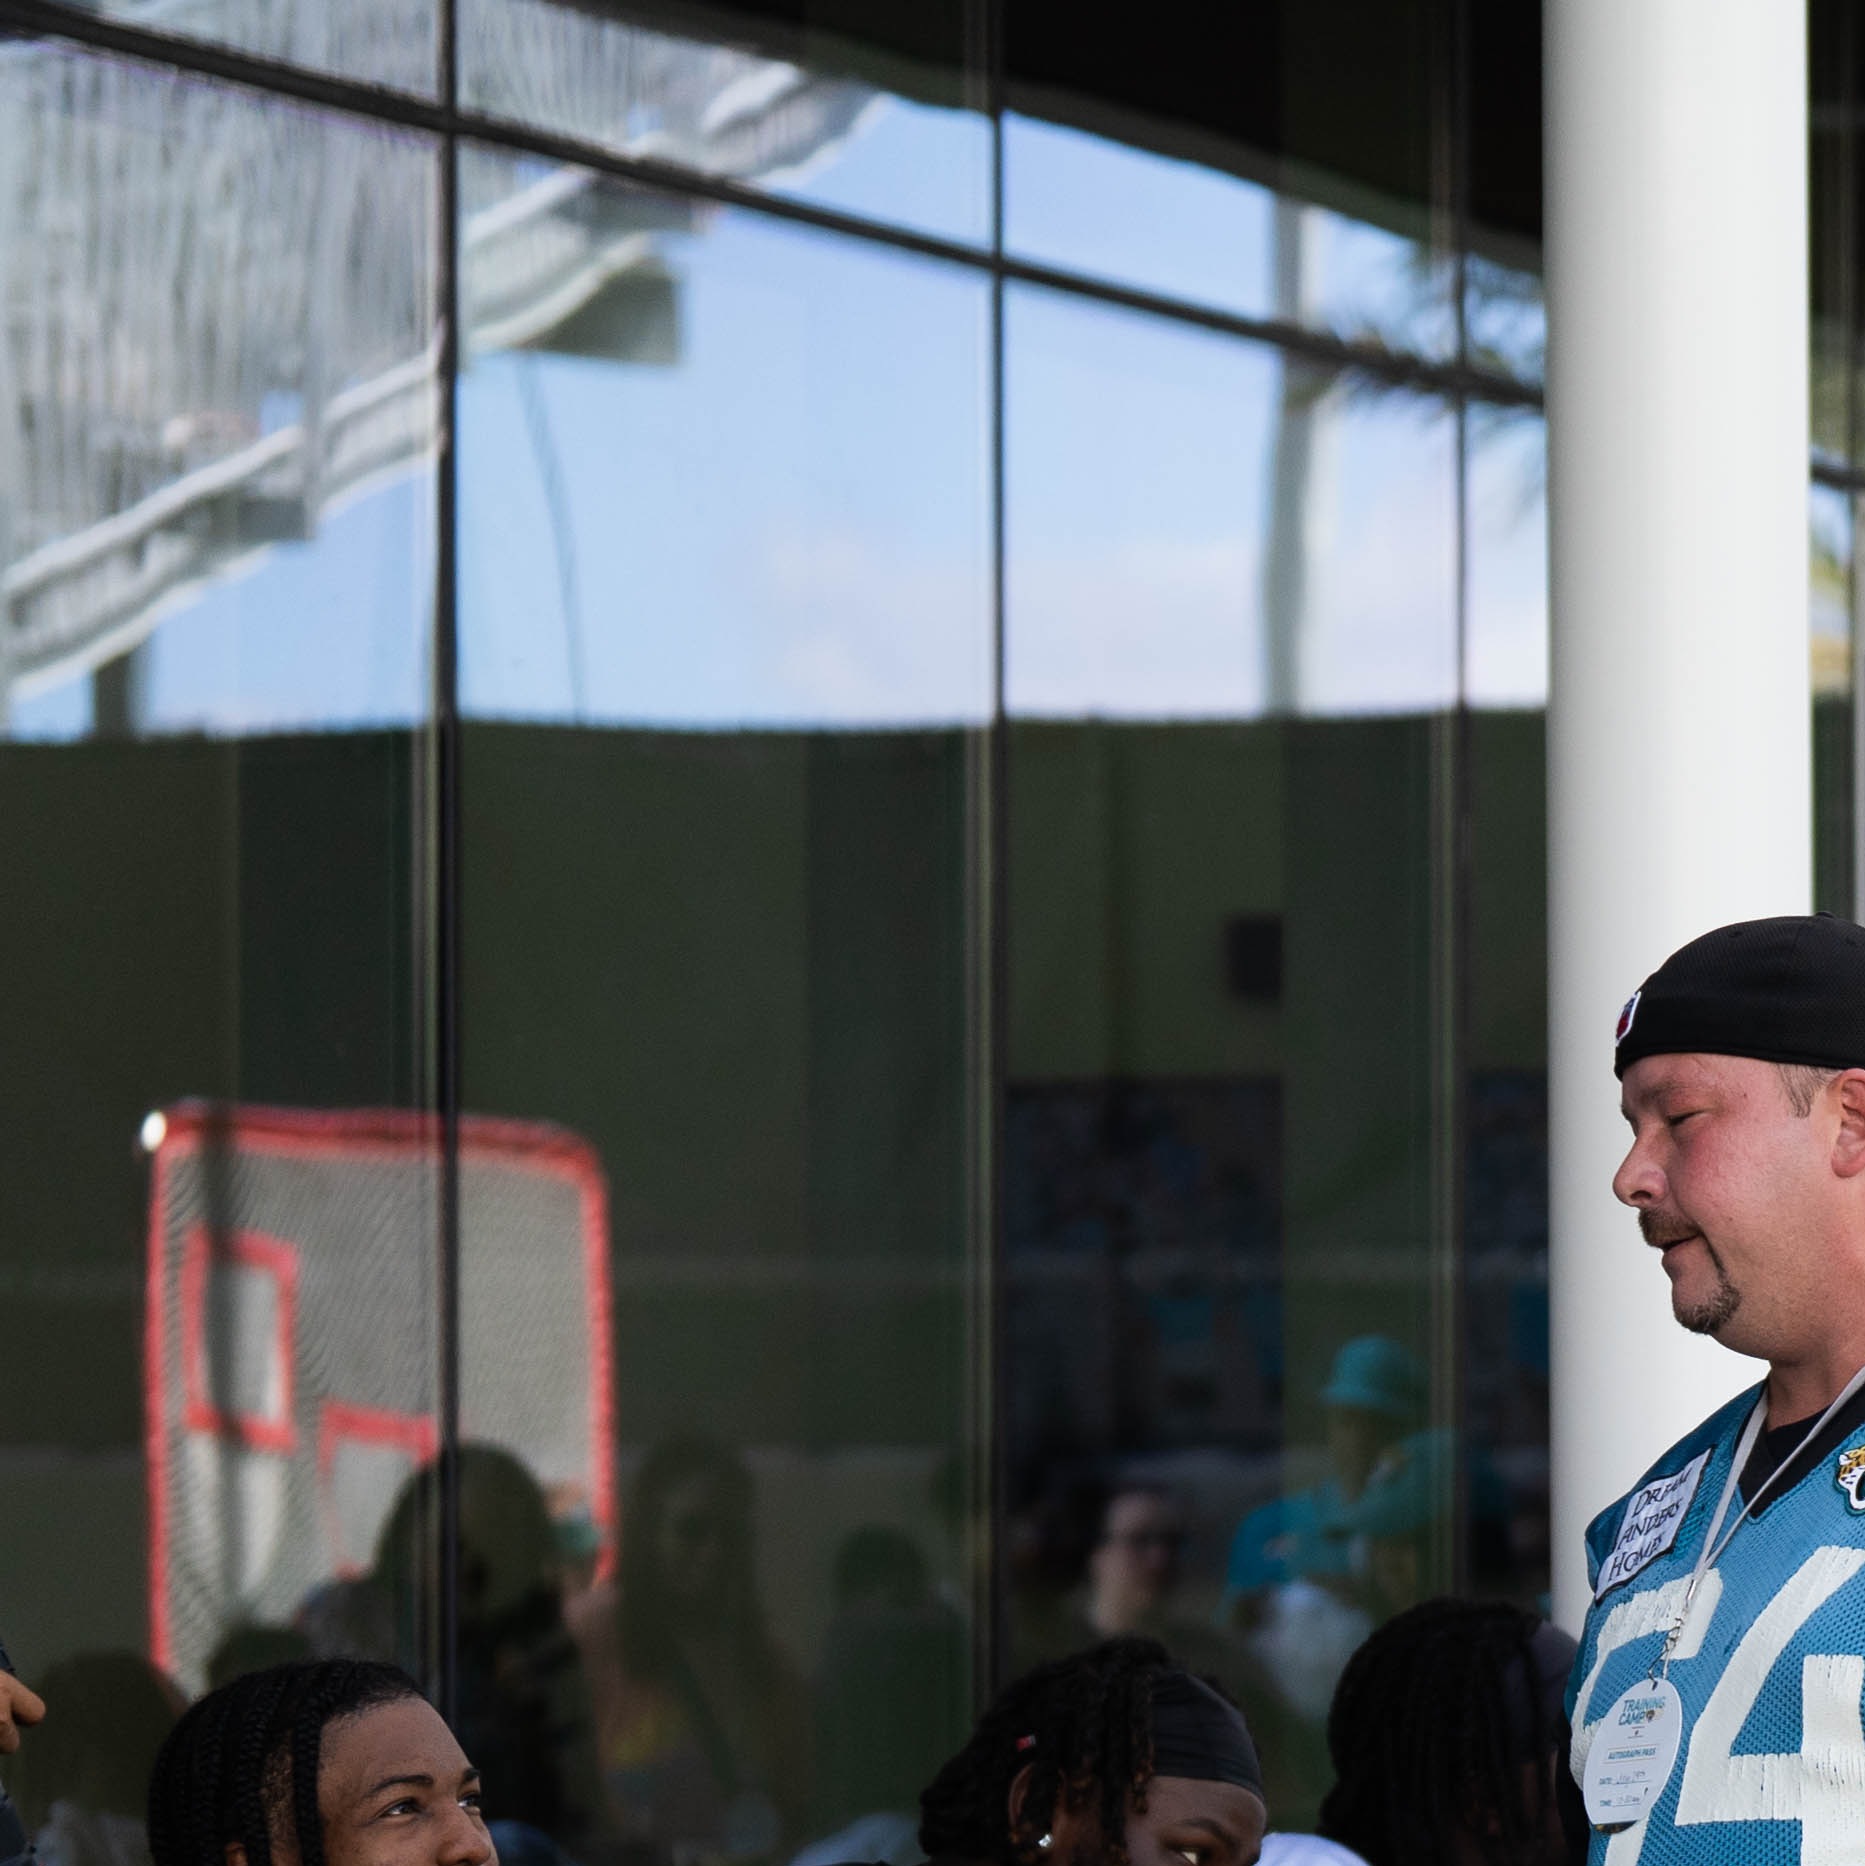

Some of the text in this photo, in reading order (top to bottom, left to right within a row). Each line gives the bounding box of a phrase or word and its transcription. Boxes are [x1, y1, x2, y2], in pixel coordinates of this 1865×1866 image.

[1631, 1467, 1693, 1518] DREAM
[1608, 1531, 1666, 1582] HOMES
[1618, 1710, 1646, 1726] CAMP
[1622, 1696, 1667, 1714] TRAINING
